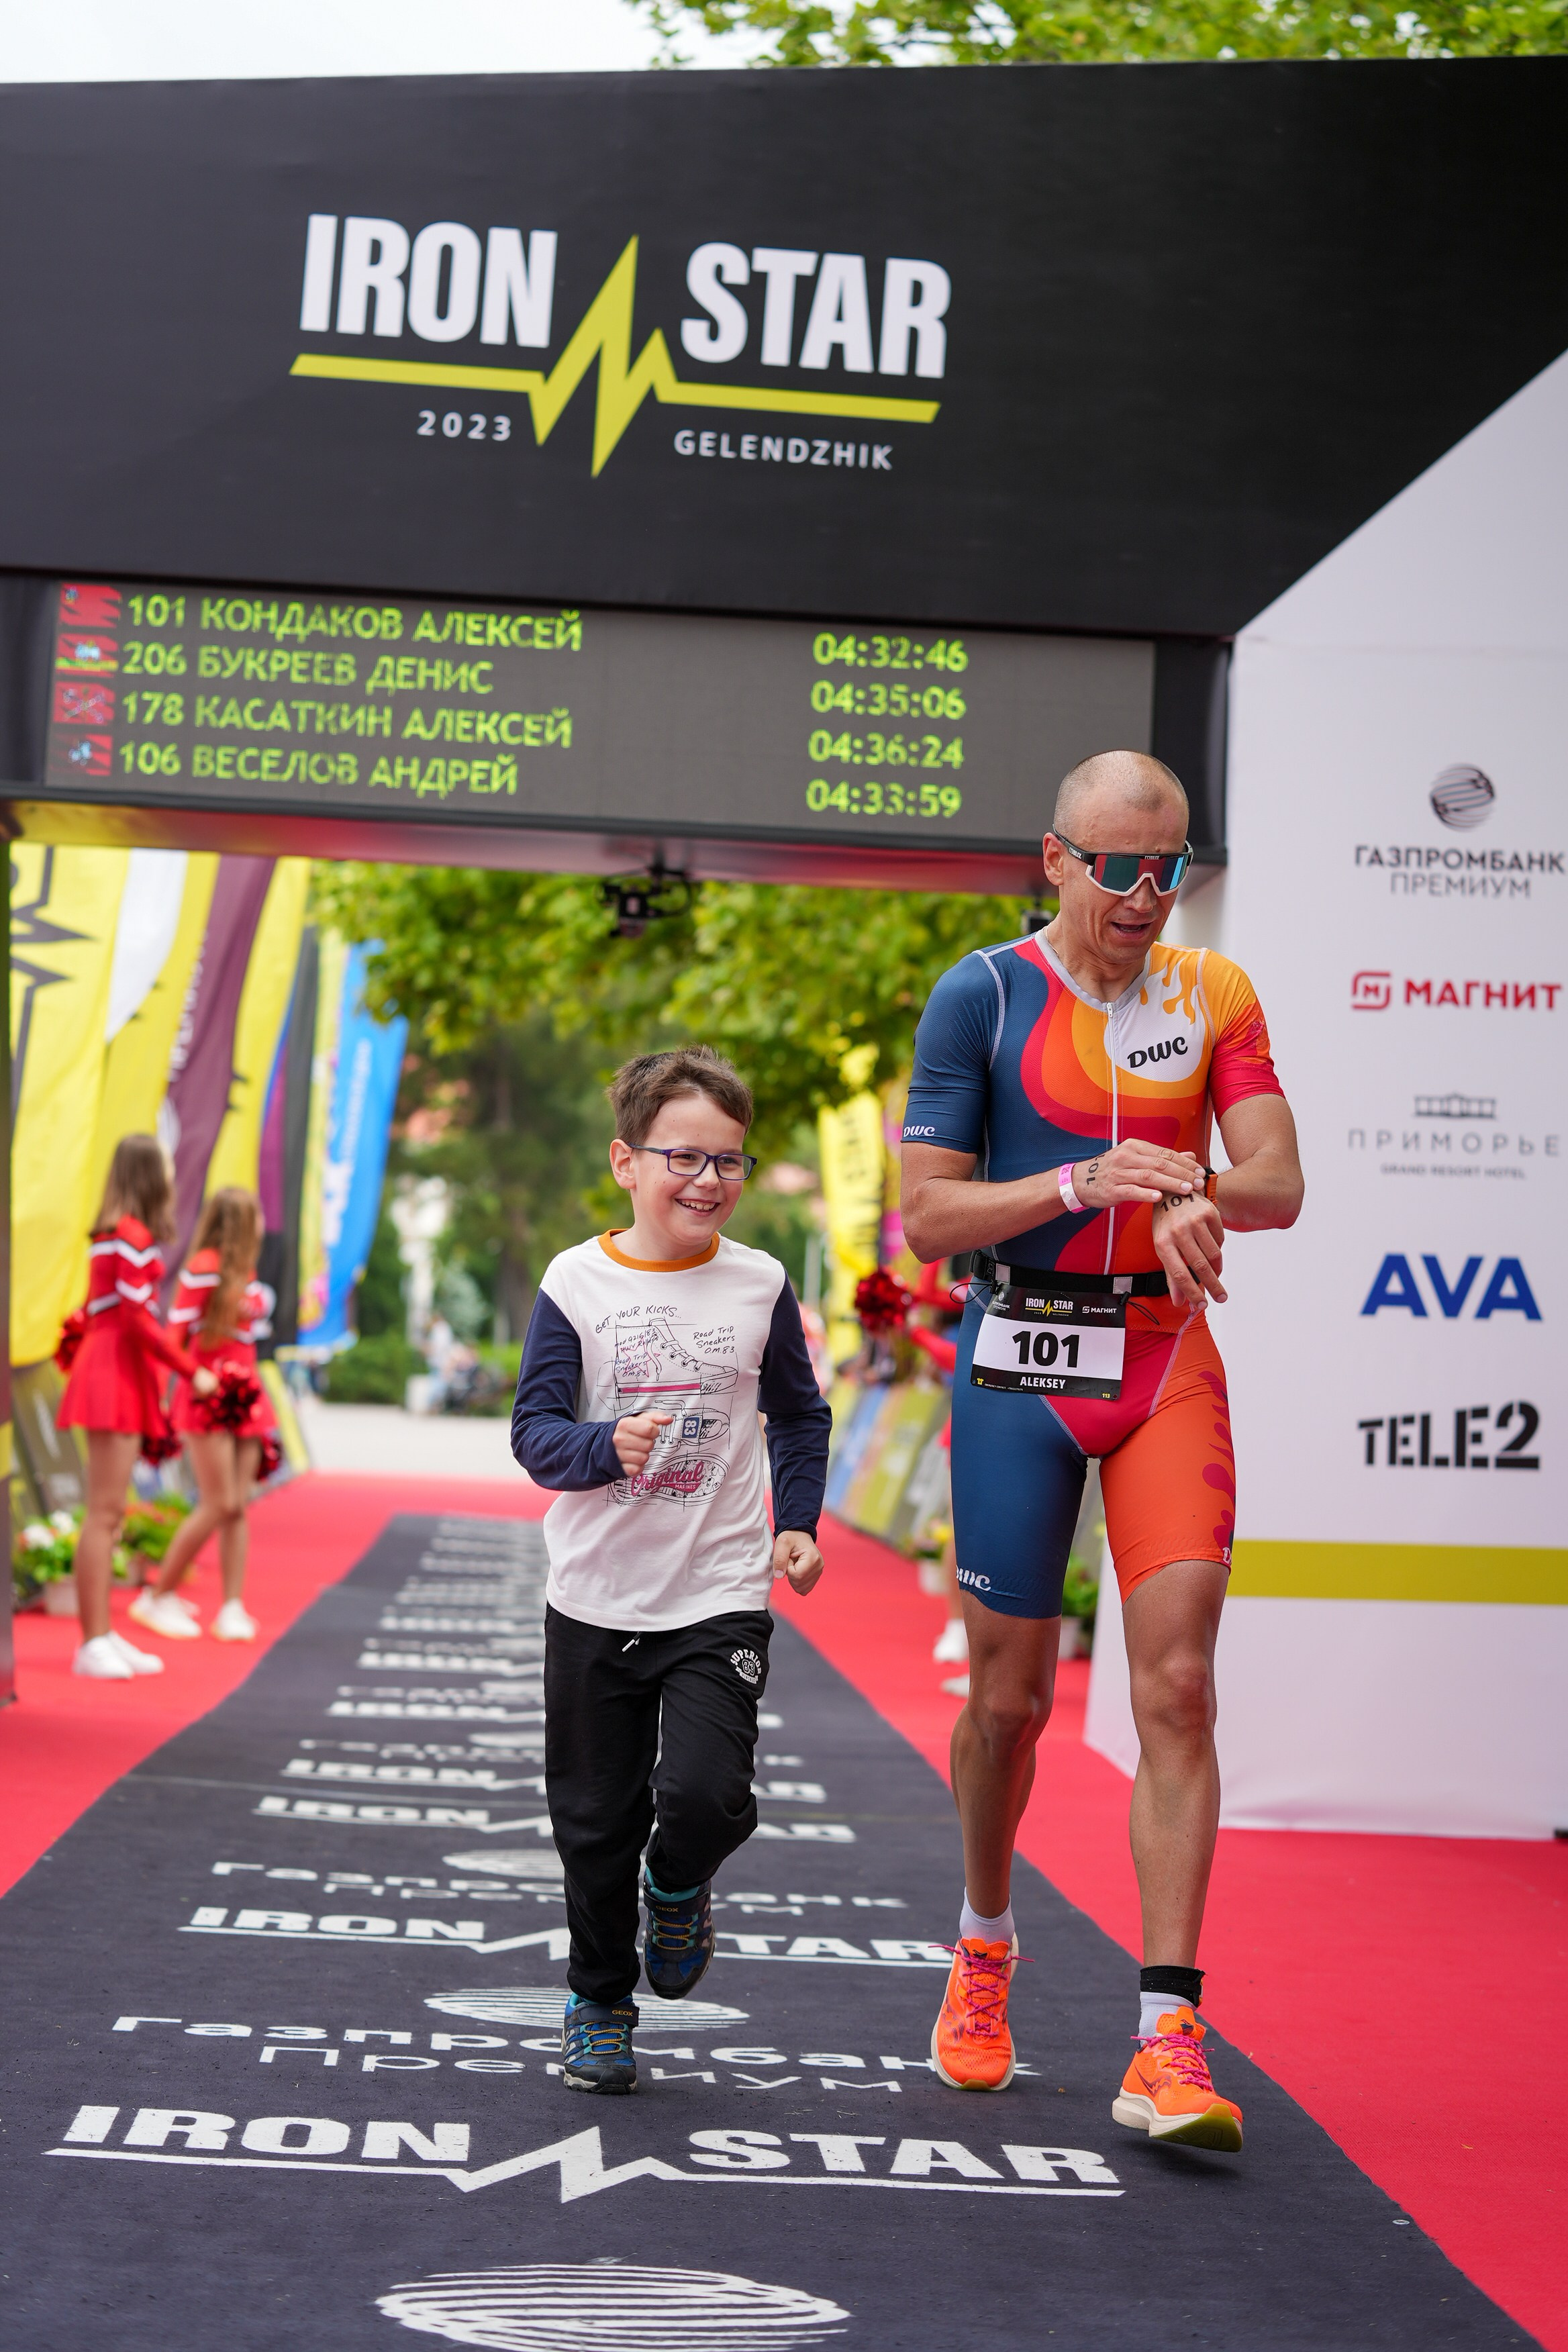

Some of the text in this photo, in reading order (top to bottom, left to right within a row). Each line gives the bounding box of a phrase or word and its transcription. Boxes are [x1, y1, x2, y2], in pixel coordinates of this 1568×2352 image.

[299, 213, 952, 379] IRON STAR
[417, 410, 511, 442] 2023
[674, 430, 893, 471] GELENDZHIK
[128, 594, 969, 672] 101 КОНДАКОВ АЛЕКСЕЙ 04:32:46
[122, 642, 967, 720] 206 БУКРЕЕВ ДЕНИС 04:35:06
[122, 691, 965, 769] 178 КАСАТКИН АЛЕКСЕЙ 04:36:24
[119, 742, 962, 818] 106 ВЕСЕЛОВ АНДРЕЙ 04:33:59
[1354, 845, 1565, 875] ГАЗПРОМБАНК
[1389, 873, 1532, 899] ПРЕМИУМ
[1405, 979, 1563, 1010] МАГНИТ
[1126, 1036, 1188, 1069] DWC
[903, 1124, 936, 1138] DWC
[1348, 1128, 1561, 1157] ПРИМОРЬЕ
[1359, 1253, 1543, 1322] AVA
[1026, 1297, 1074, 1310] IRON STAR
[693, 1328, 714, 1340] Road
[696, 1335, 736, 1349] Sneakers
[1012, 1330, 1080, 1368] 101
[1020, 1376, 1066, 1389] ALEKSEY
[684, 1420, 697, 1436] 83
[1357, 1400, 1541, 1470] TELE2
[631, 1461, 705, 1497] Original
[730, 1649, 762, 1674] SUPERIOR
[742, 1659, 755, 1677] 83
[259, 1796, 490, 1824] IRON
[190, 1906, 485, 1941] IRON
[643, 1930, 953, 1961] TAR
[611, 2009, 634, 2017] GEOX
[62, 2105, 471, 2162] IRON
[689, 2129, 1120, 2184] STAR
